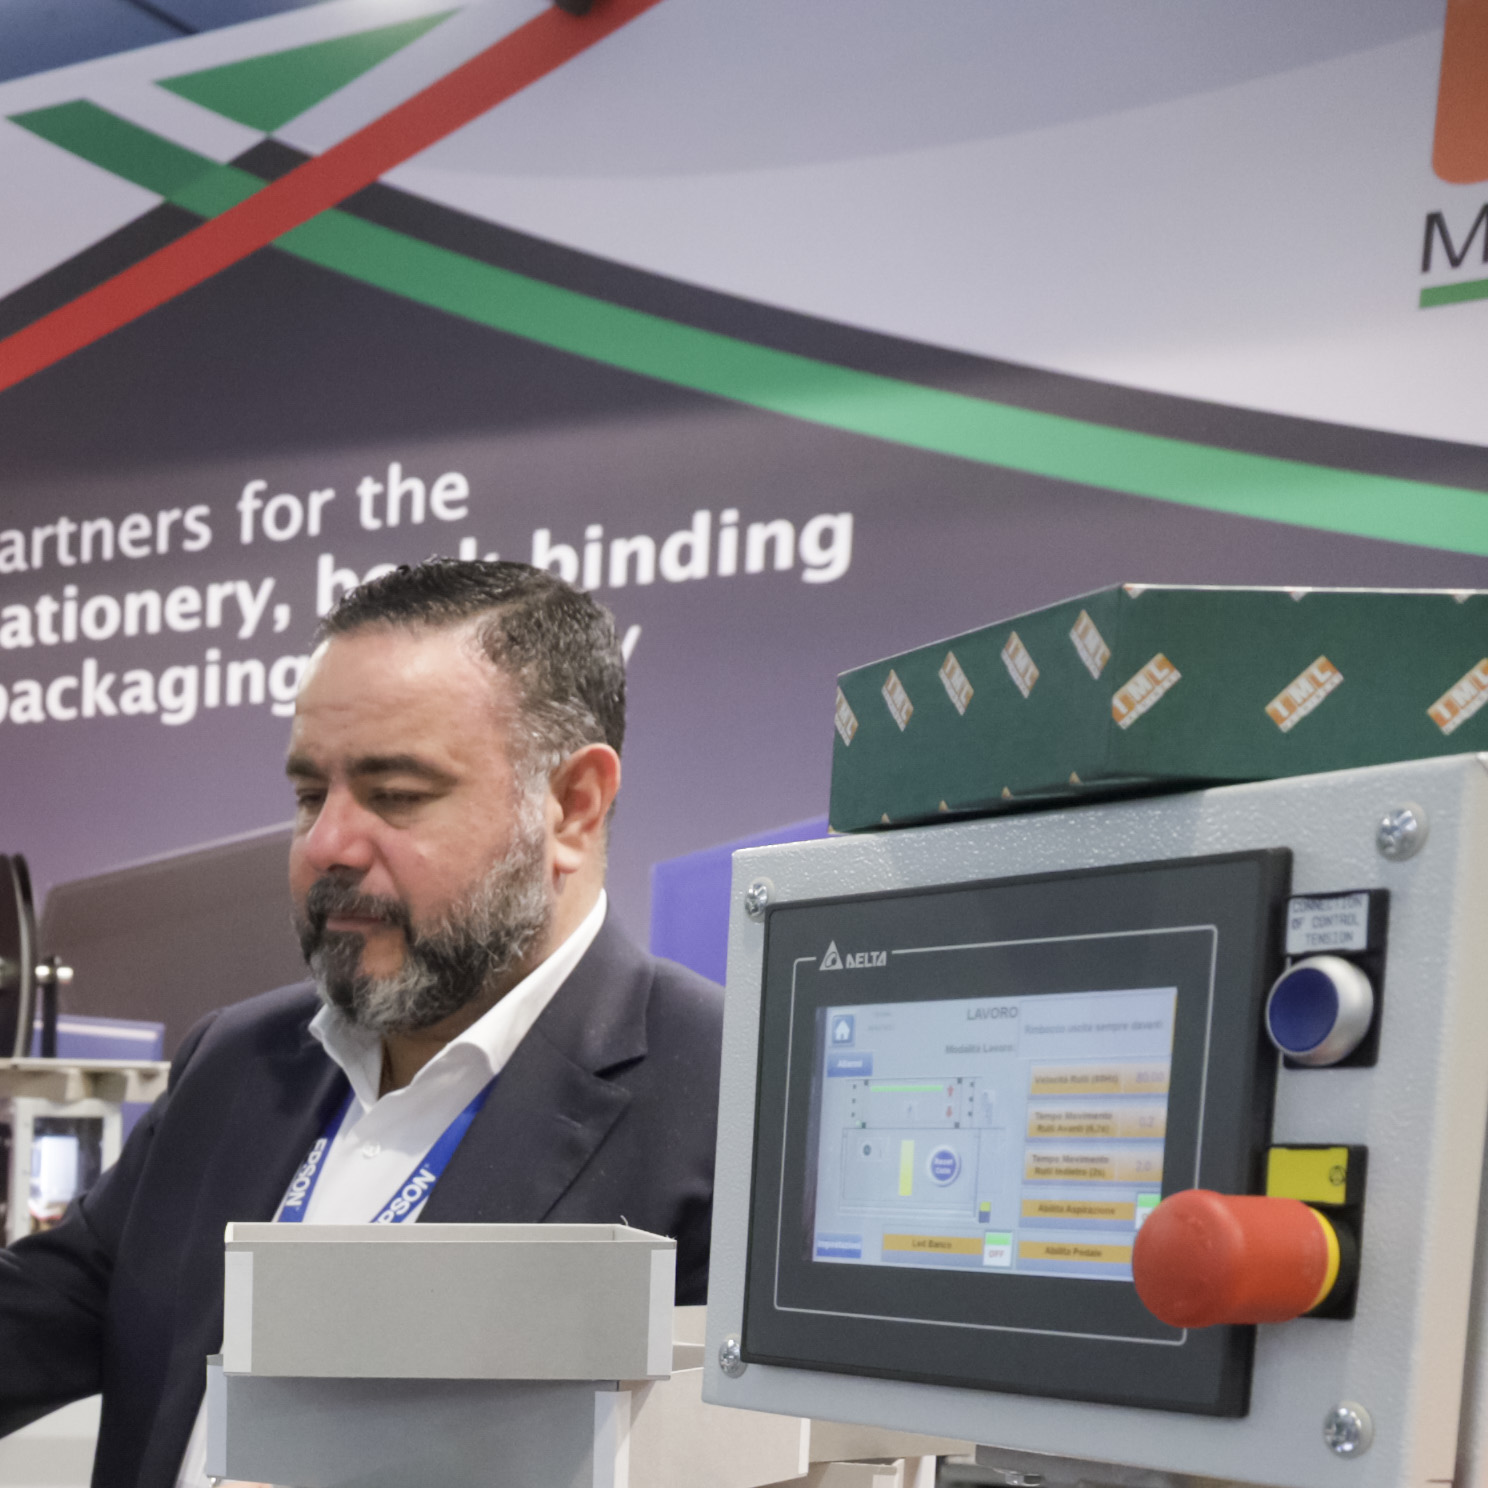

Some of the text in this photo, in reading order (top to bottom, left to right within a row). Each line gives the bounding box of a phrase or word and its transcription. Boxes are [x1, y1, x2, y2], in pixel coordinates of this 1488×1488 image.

[238, 479, 334, 541] for
[357, 462, 471, 531] the
[532, 509, 855, 591] binding
[966, 1006, 1018, 1021] LAVORO
[377, 1168, 437, 1223] PSON
